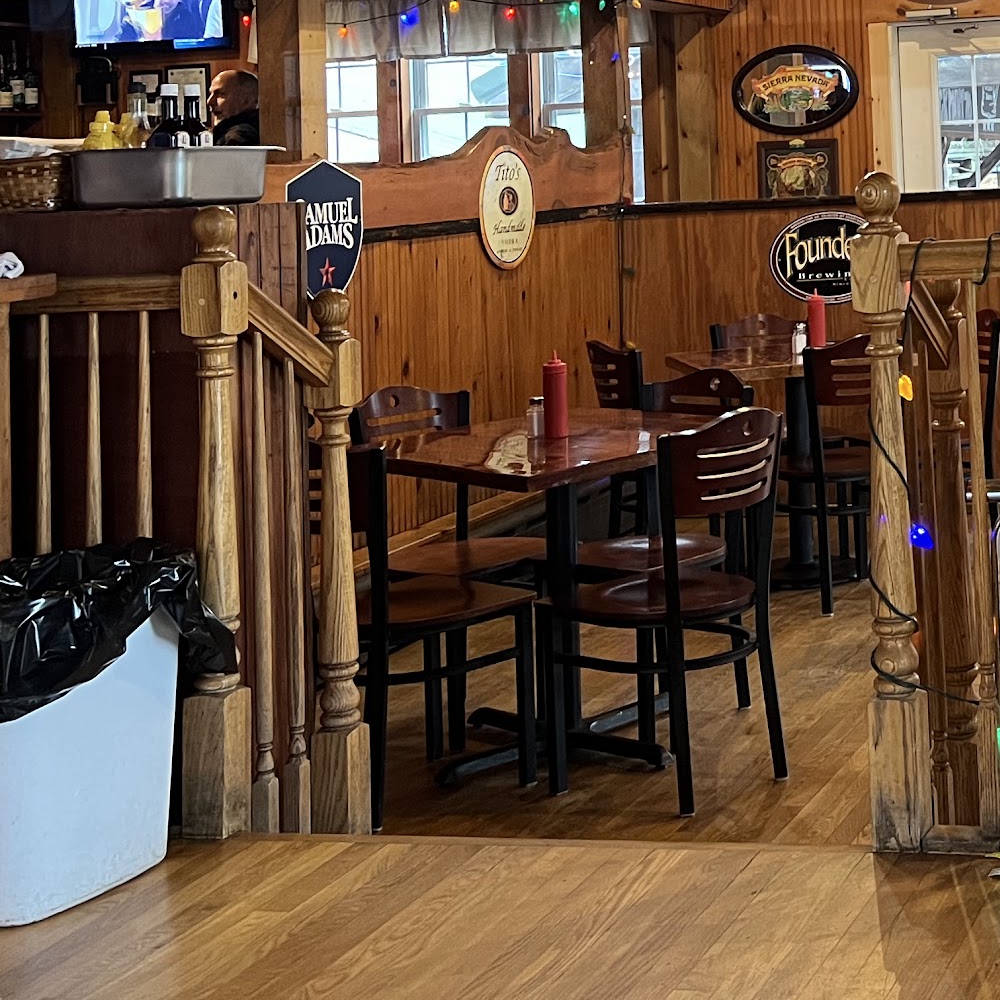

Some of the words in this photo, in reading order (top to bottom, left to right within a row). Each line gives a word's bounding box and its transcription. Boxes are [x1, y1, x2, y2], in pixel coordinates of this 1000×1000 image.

[762, 74, 794, 91] SIERRA
[794, 73, 831, 88] NEVADA
[494, 163, 521, 182] Tito's
[296, 197, 358, 225] AMUEL
[784, 224, 852, 280] Founde
[798, 270, 852, 281] Brewin
